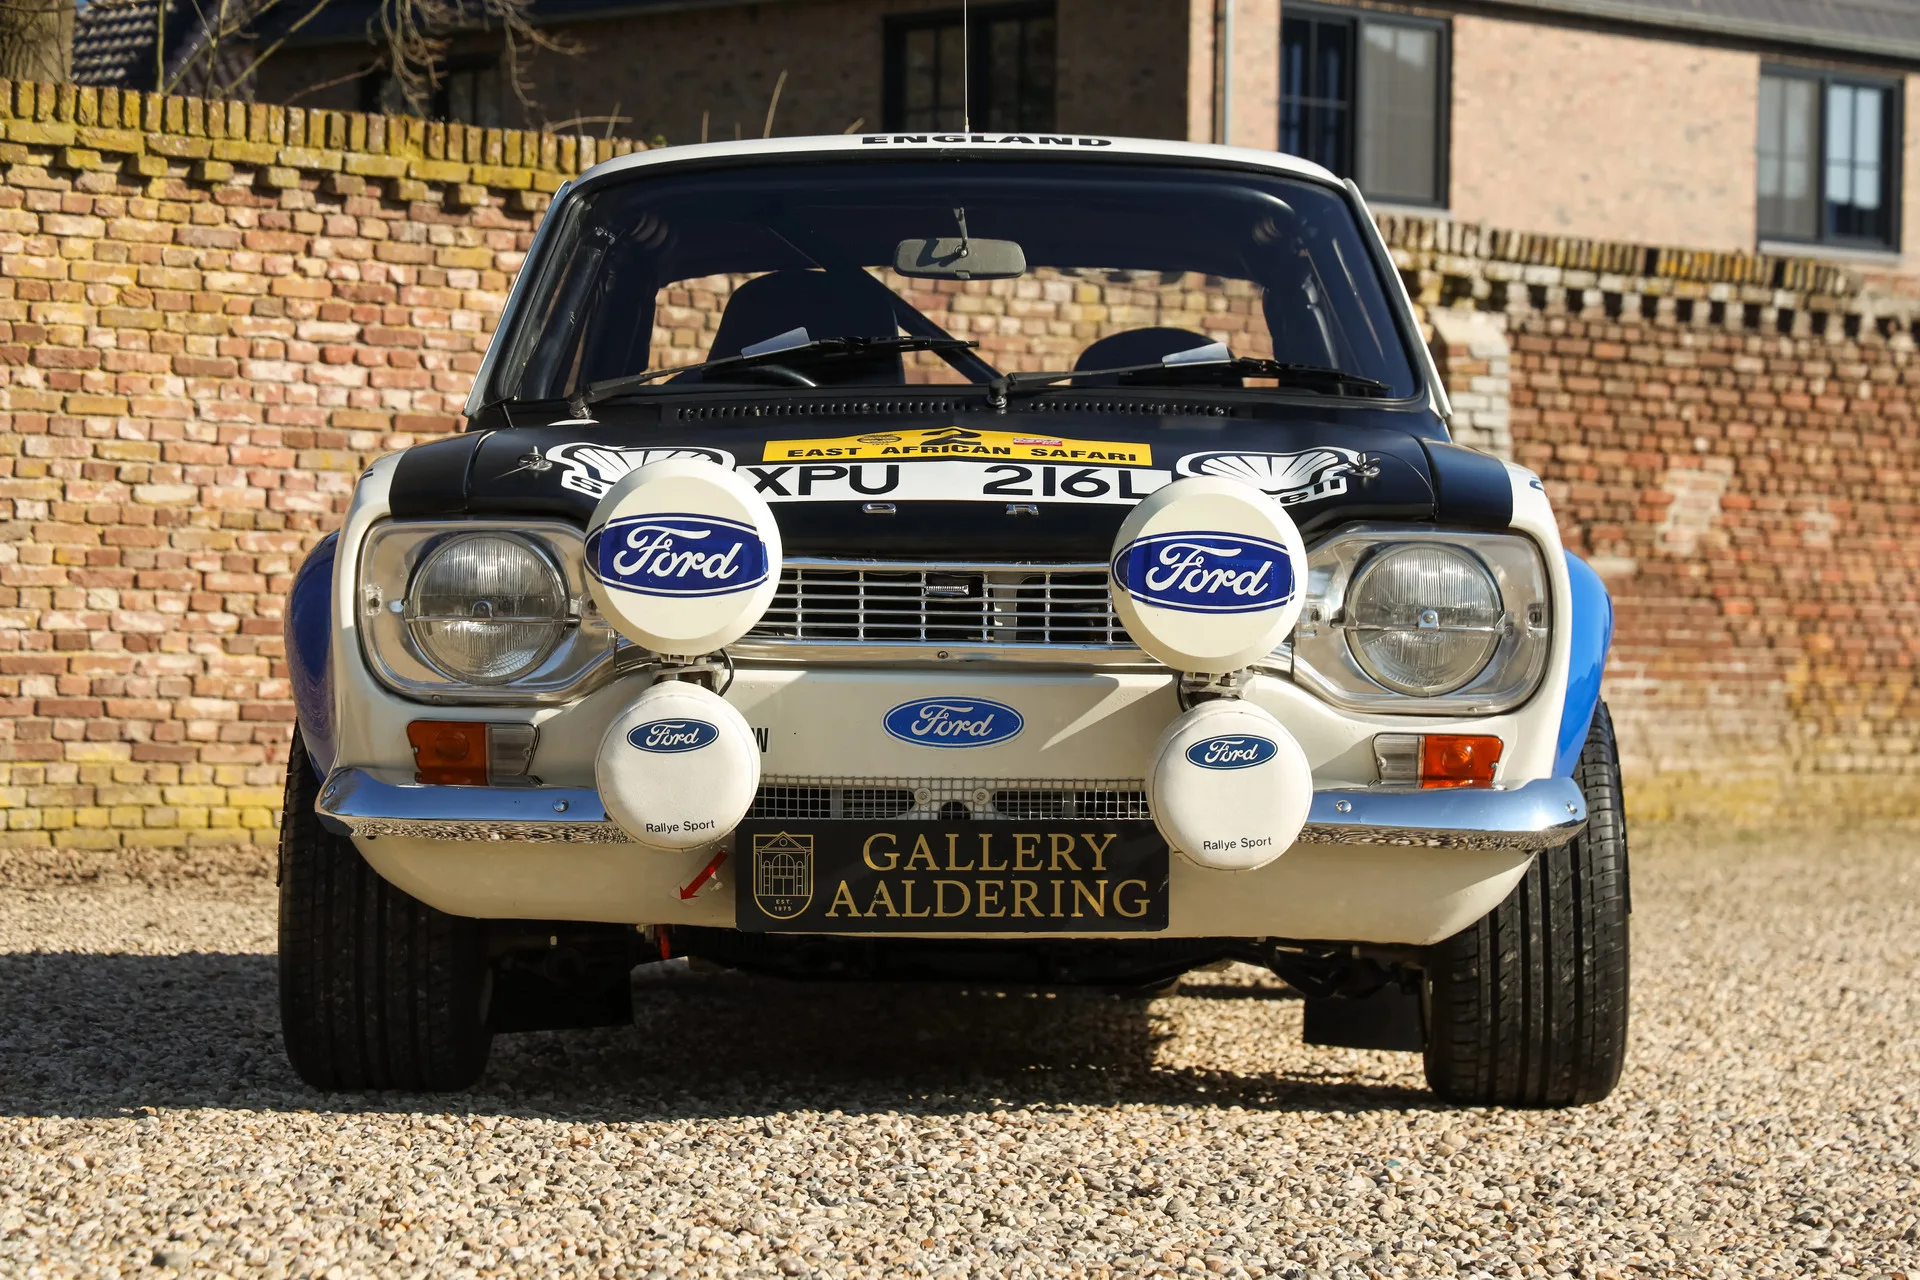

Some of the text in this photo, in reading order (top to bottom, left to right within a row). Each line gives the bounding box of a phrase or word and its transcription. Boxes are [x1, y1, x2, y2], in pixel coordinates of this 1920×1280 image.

[862, 135, 1112, 147] ENGLAND
[920, 428, 982, 446] 2
[787, 445, 1137, 462] EAST AFRICAN SAFARI
[746, 464, 1152, 499] XPU 216L
[613, 525, 743, 580] Ford
[1145, 543, 1273, 597] Ford
[911, 704, 995, 737] Ford
[645, 723, 699, 747] Ford
[1204, 739, 1259, 764] Ford
[646, 819, 716, 834] Rallye Sport
[863, 833, 1117, 872] GALLERY
[1203, 836, 1272, 852] Rallye Sport
[825, 879, 1151, 919] AALDERING
